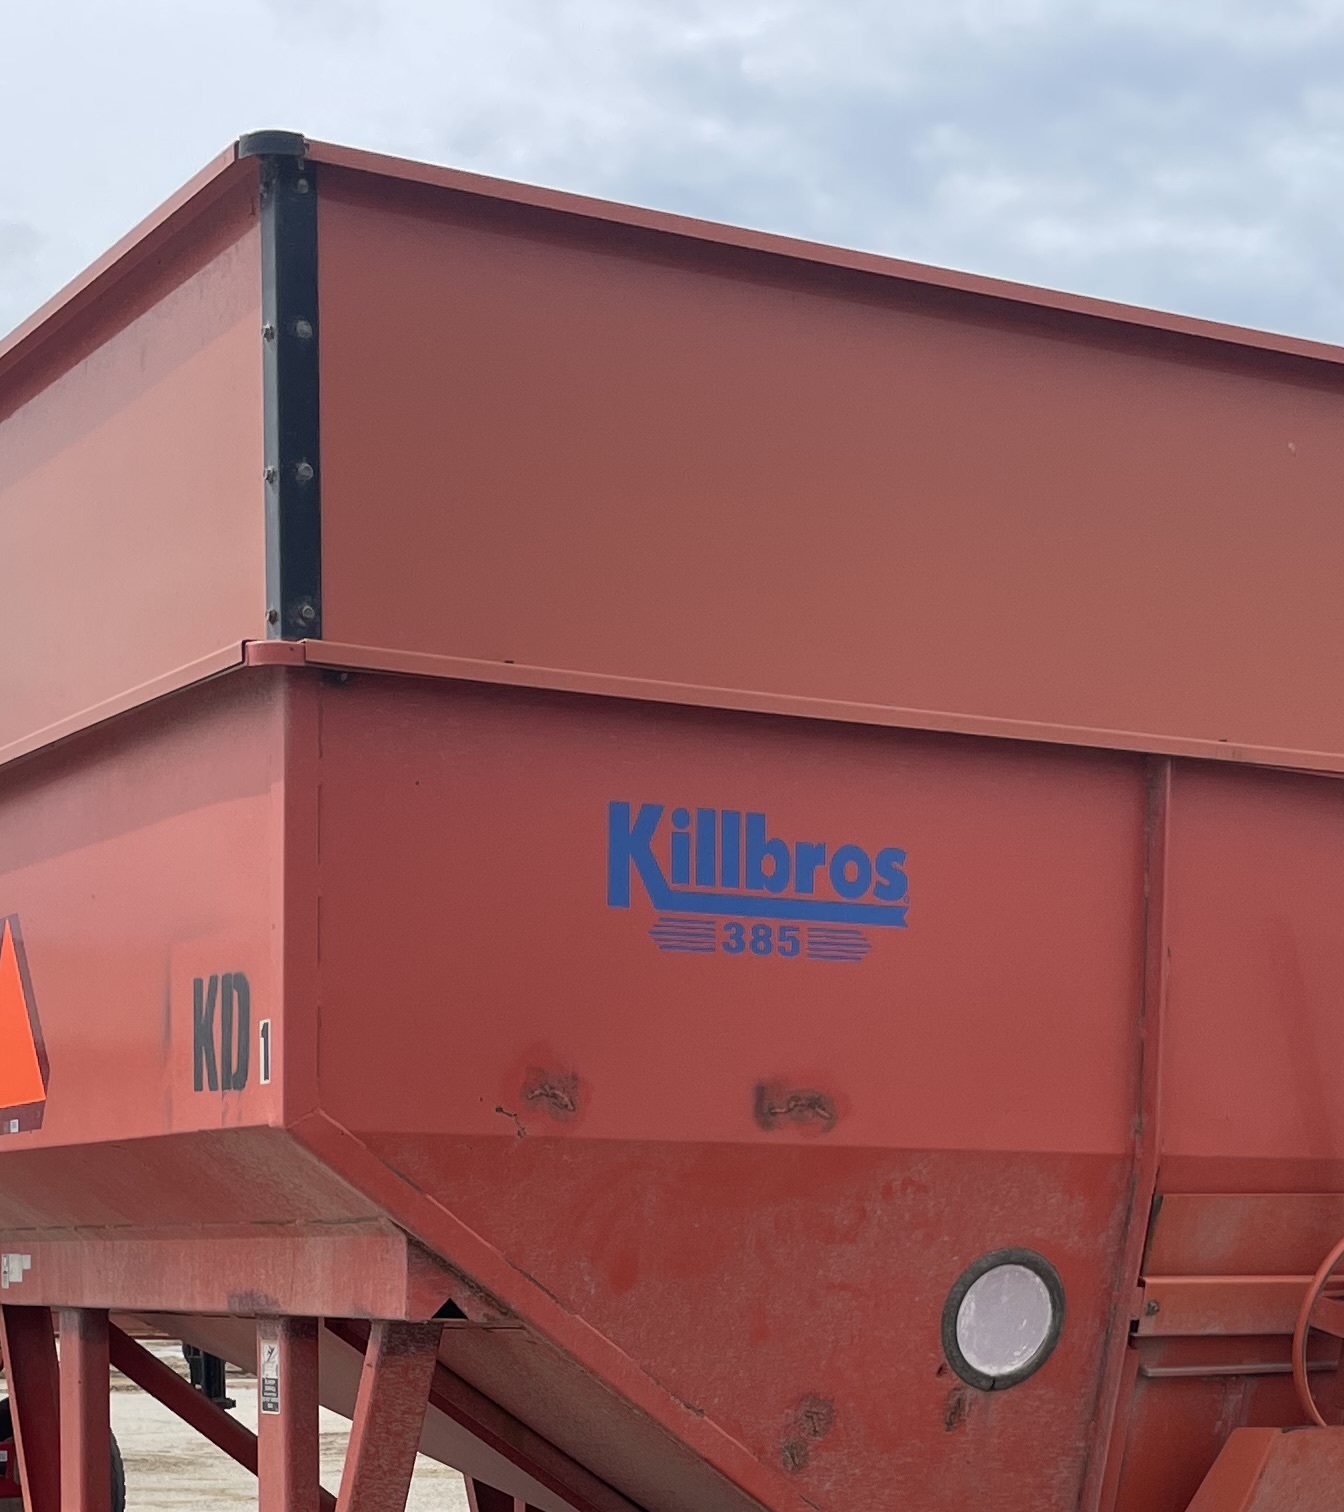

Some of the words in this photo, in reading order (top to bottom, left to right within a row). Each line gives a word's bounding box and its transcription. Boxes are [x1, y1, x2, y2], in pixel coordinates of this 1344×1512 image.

[607, 801, 908, 909] Killbros
[721, 921, 801, 958] 385
[193, 971, 250, 1091] KD
[261, 1022, 269, 1081] 1
